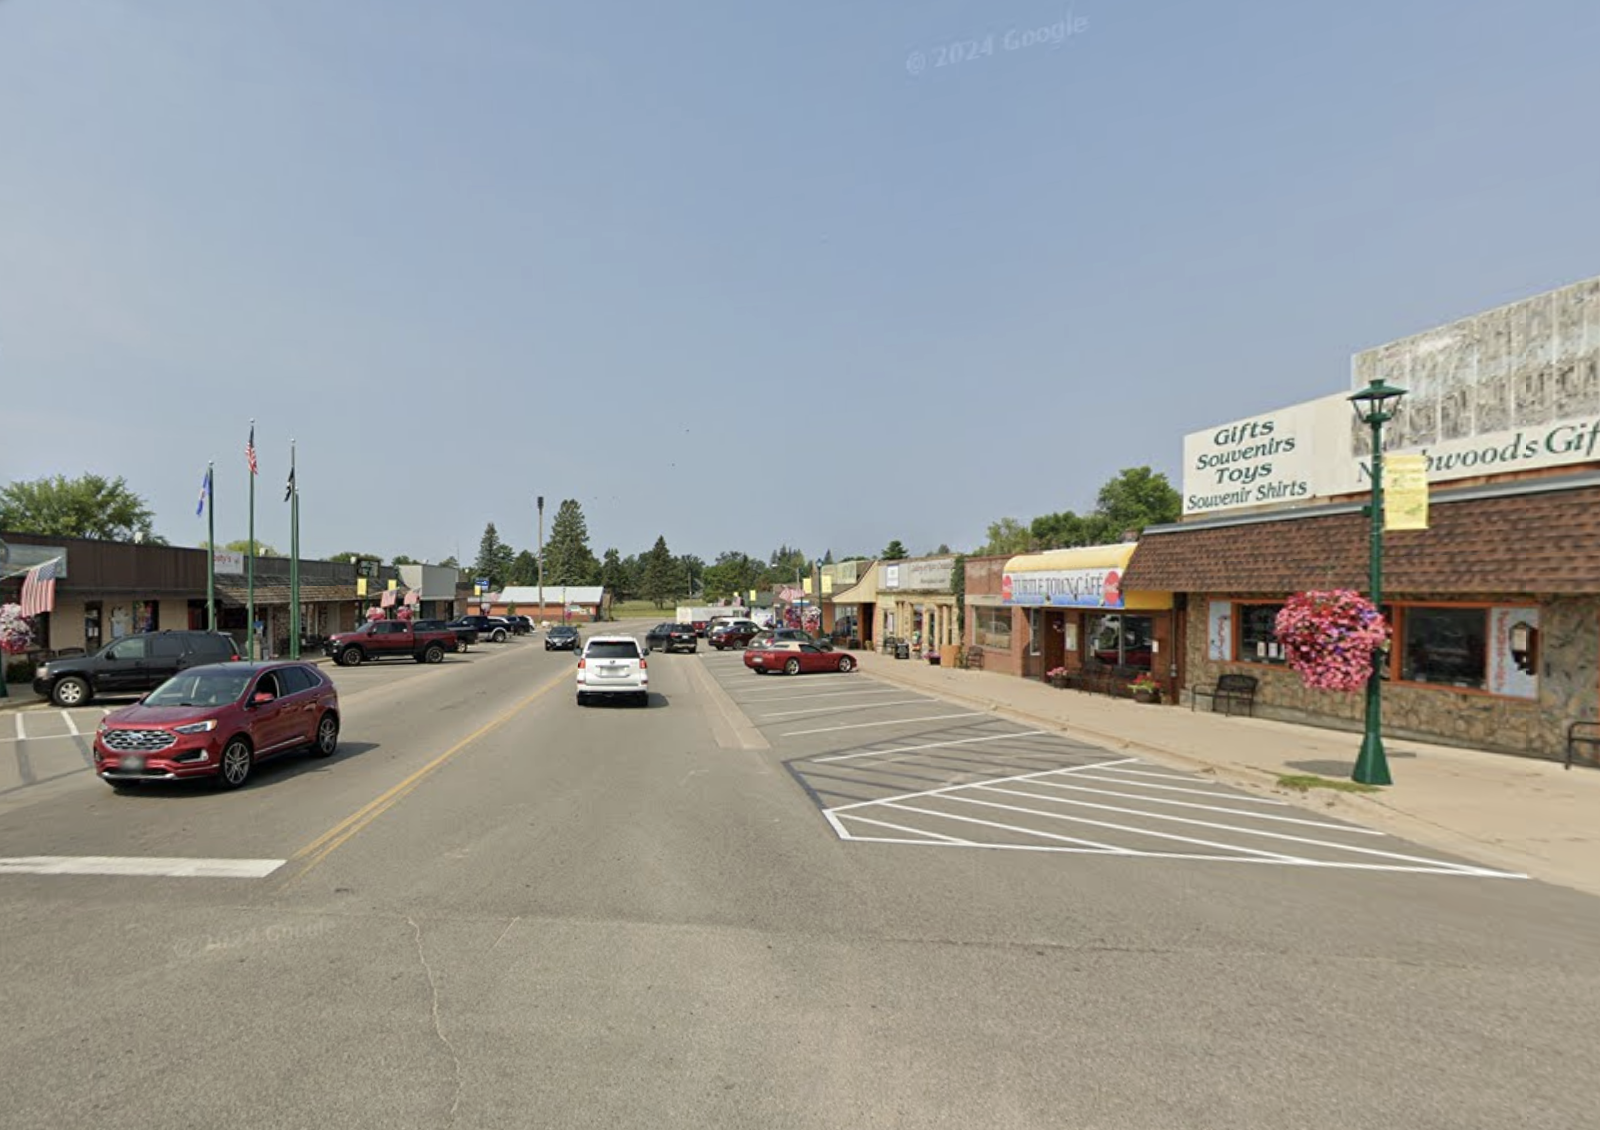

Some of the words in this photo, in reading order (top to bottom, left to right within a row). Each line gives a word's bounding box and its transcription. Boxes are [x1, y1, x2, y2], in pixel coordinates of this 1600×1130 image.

[1214, 420, 1274, 446] Gifts
[1196, 437, 1295, 470] Souvenirs
[1216, 462, 1272, 485] Toys
[1187, 488, 1251, 511] Souvenir
[1255, 481, 1308, 502] Shirts
